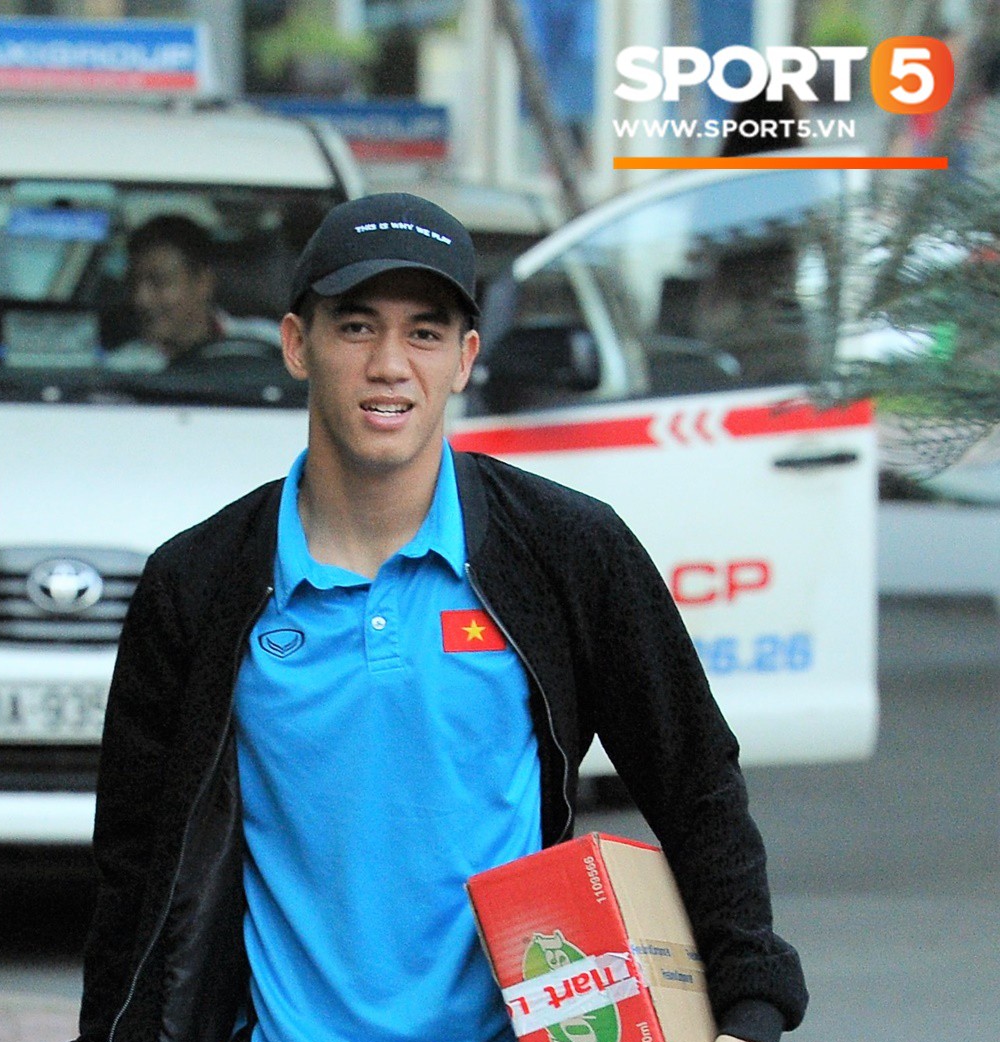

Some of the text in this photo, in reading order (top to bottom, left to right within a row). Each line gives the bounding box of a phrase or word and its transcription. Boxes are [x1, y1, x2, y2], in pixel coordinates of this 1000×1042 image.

[354, 222, 452, 245] THIS IS WHY WE PLAY
[670, 558, 773, 605] CP
